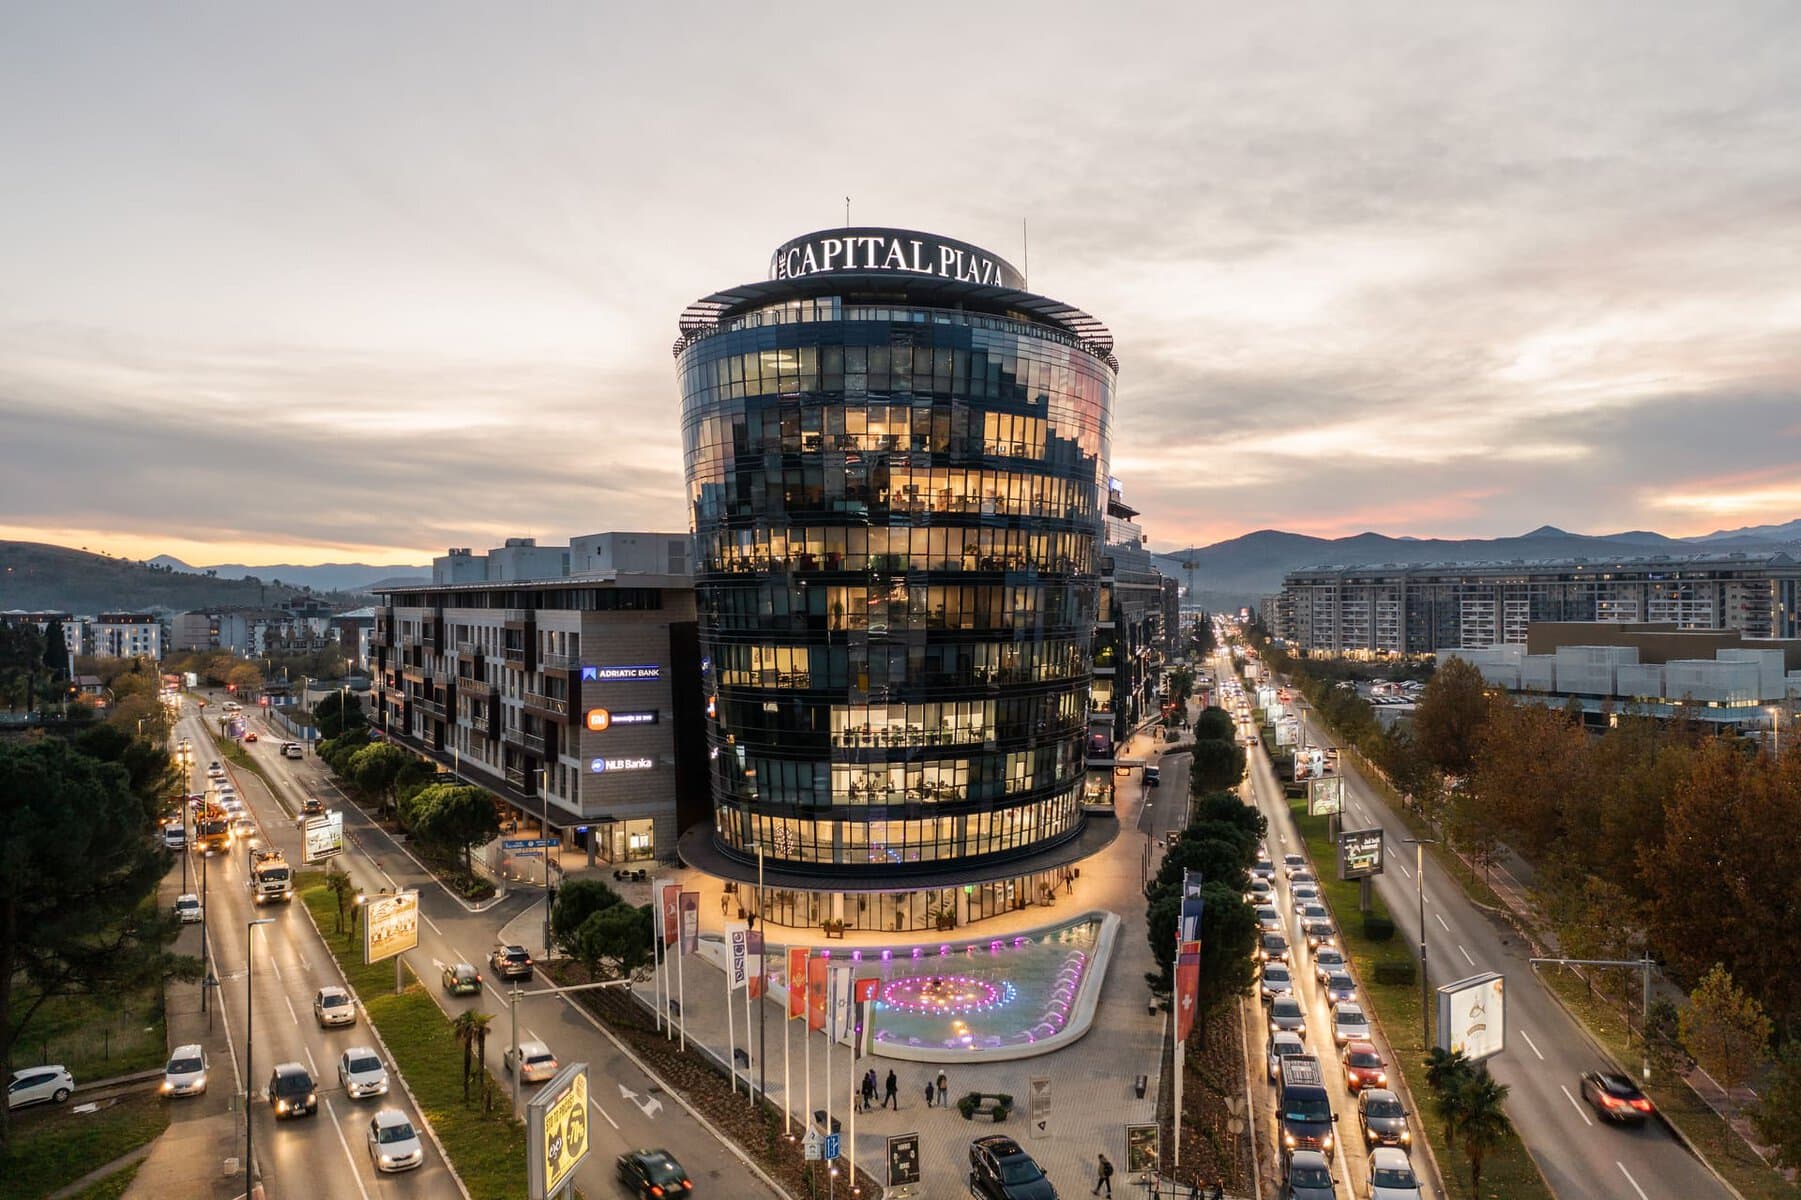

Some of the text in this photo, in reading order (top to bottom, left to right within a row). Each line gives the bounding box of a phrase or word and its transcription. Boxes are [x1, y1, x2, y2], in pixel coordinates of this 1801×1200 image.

[778, 237, 1002, 287] THE CAPITAL PLAZA
[599, 669, 660, 678] ADRIATIC BANK
[605, 758, 653, 770] NLB Banka
